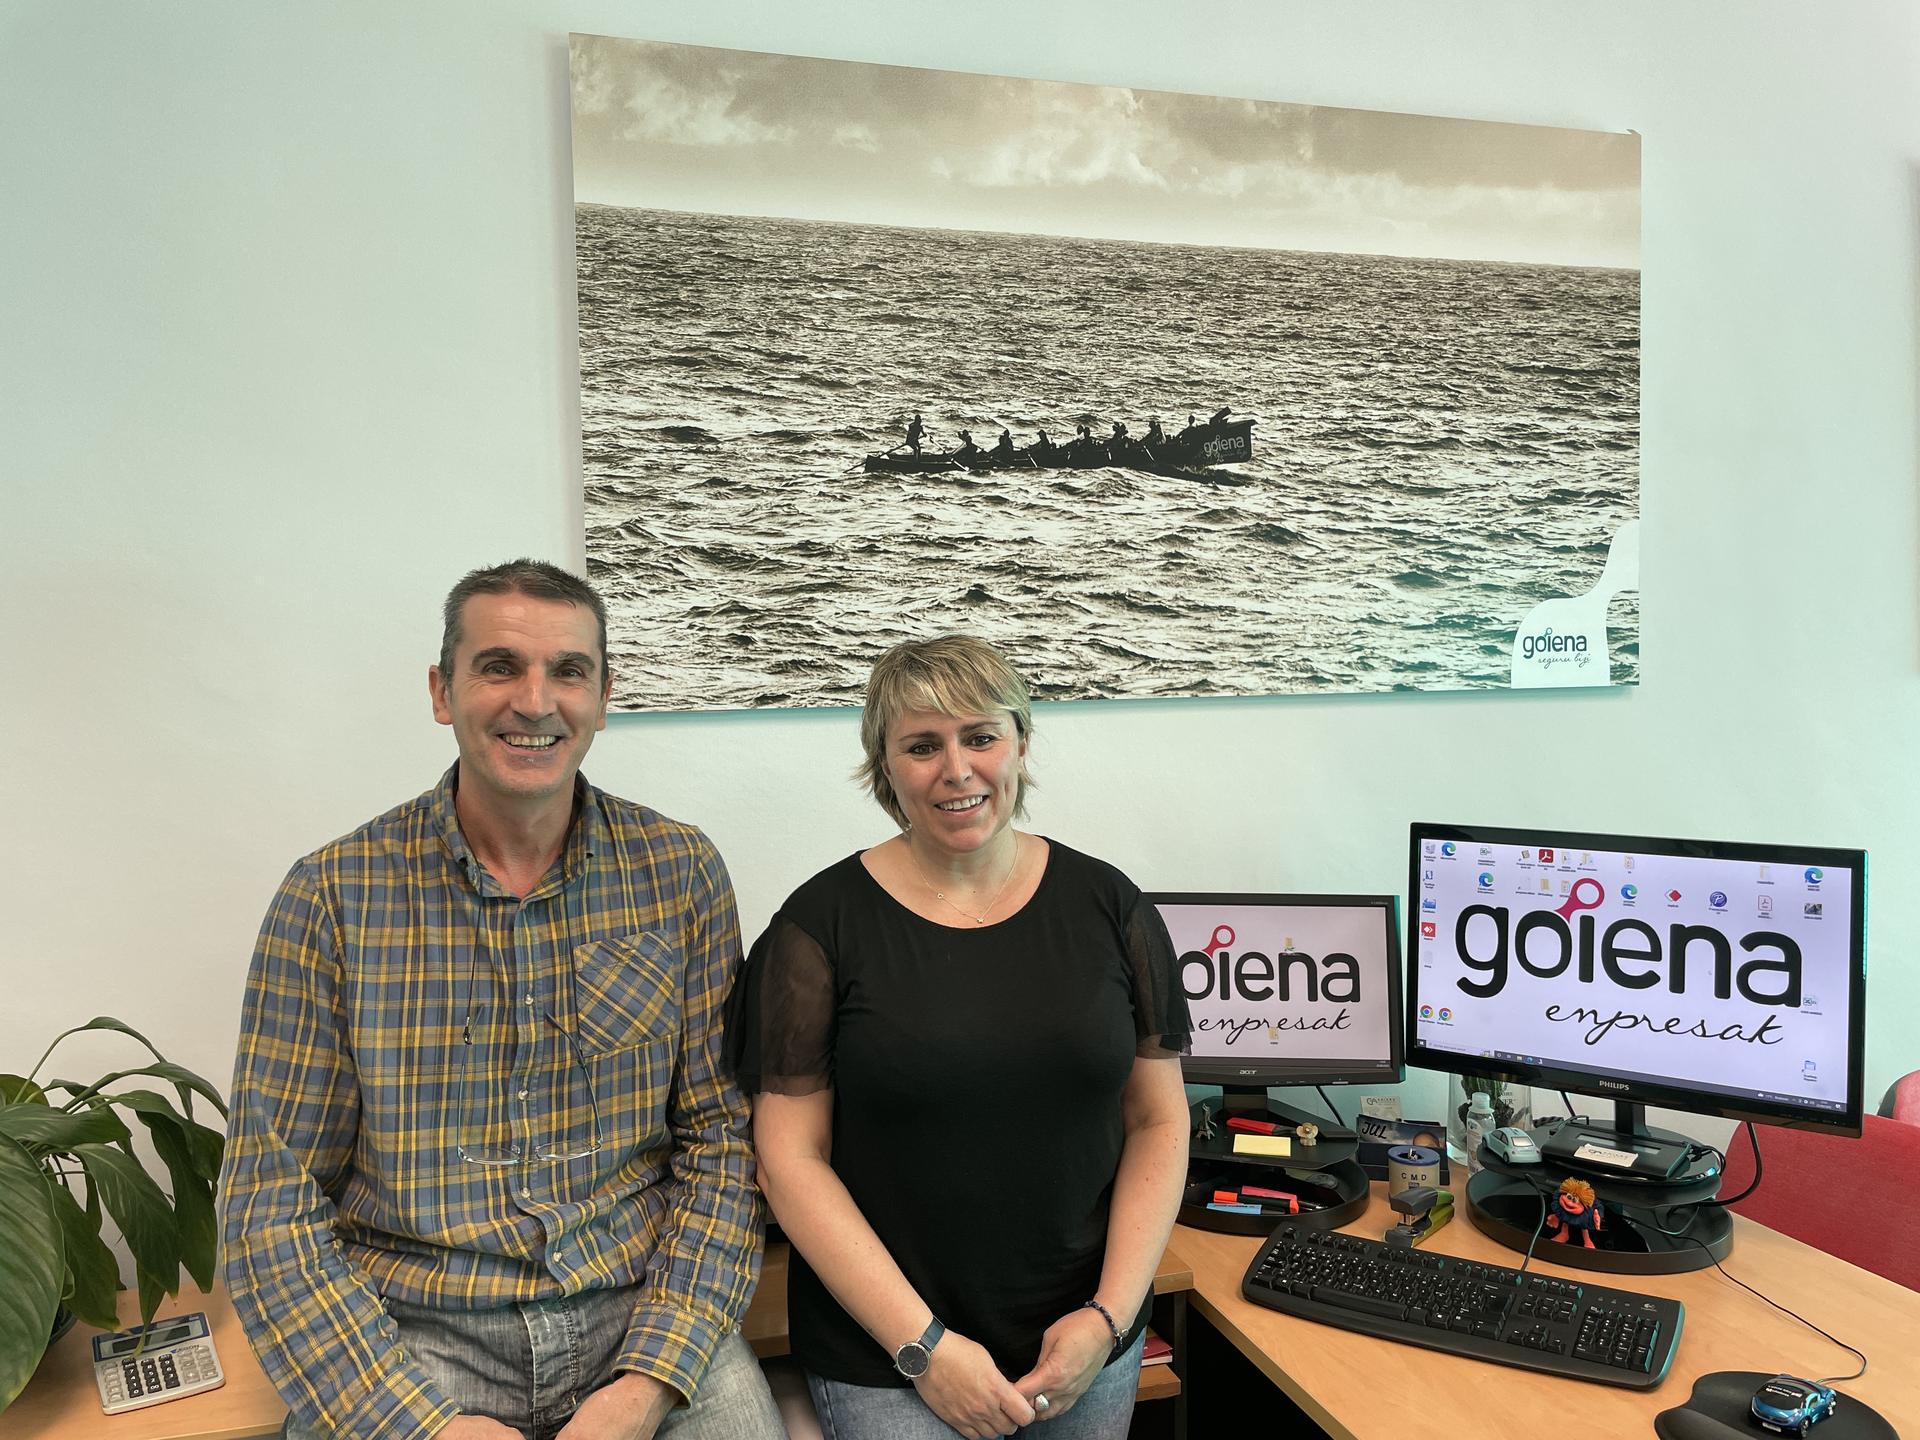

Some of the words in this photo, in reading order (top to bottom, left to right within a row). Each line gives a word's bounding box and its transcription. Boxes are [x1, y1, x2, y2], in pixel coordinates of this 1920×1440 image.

[1203, 434, 1245, 457] goiena
[1522, 627, 1588, 659] goiena
[1455, 878, 1802, 1008] goiena
[1177, 925, 1361, 1003] oiena
[1545, 1004, 1784, 1046] enpresak
[1599, 1080, 1630, 1092] PHILIPS
[1362, 1121, 1388, 1140] JUL
